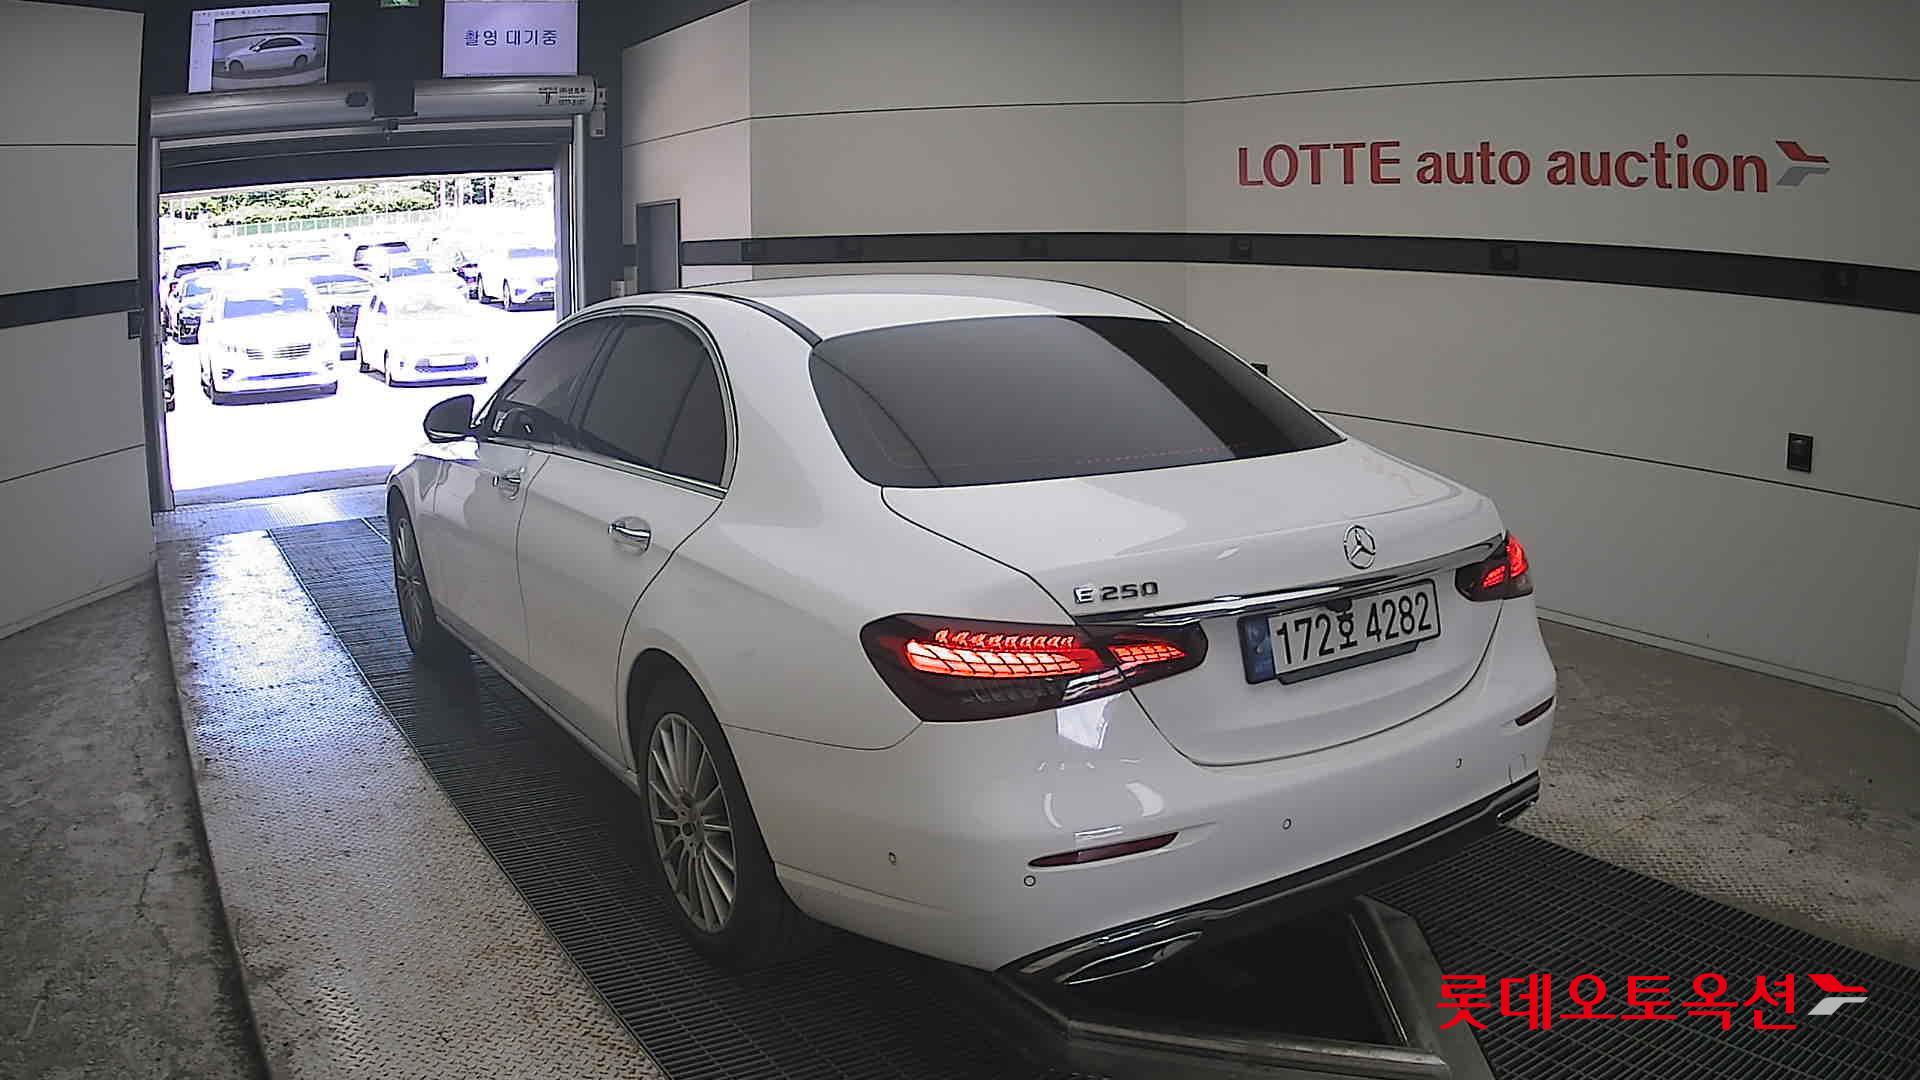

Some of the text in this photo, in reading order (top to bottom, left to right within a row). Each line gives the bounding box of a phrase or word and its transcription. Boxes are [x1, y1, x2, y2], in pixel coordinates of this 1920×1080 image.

[464, 29, 558, 47] 촬영 대기중
[1237, 134, 1768, 193] LOTTE auto auction
[1073, 582, 1159, 604] E 250
[1366, 592, 1432, 642] 4282
